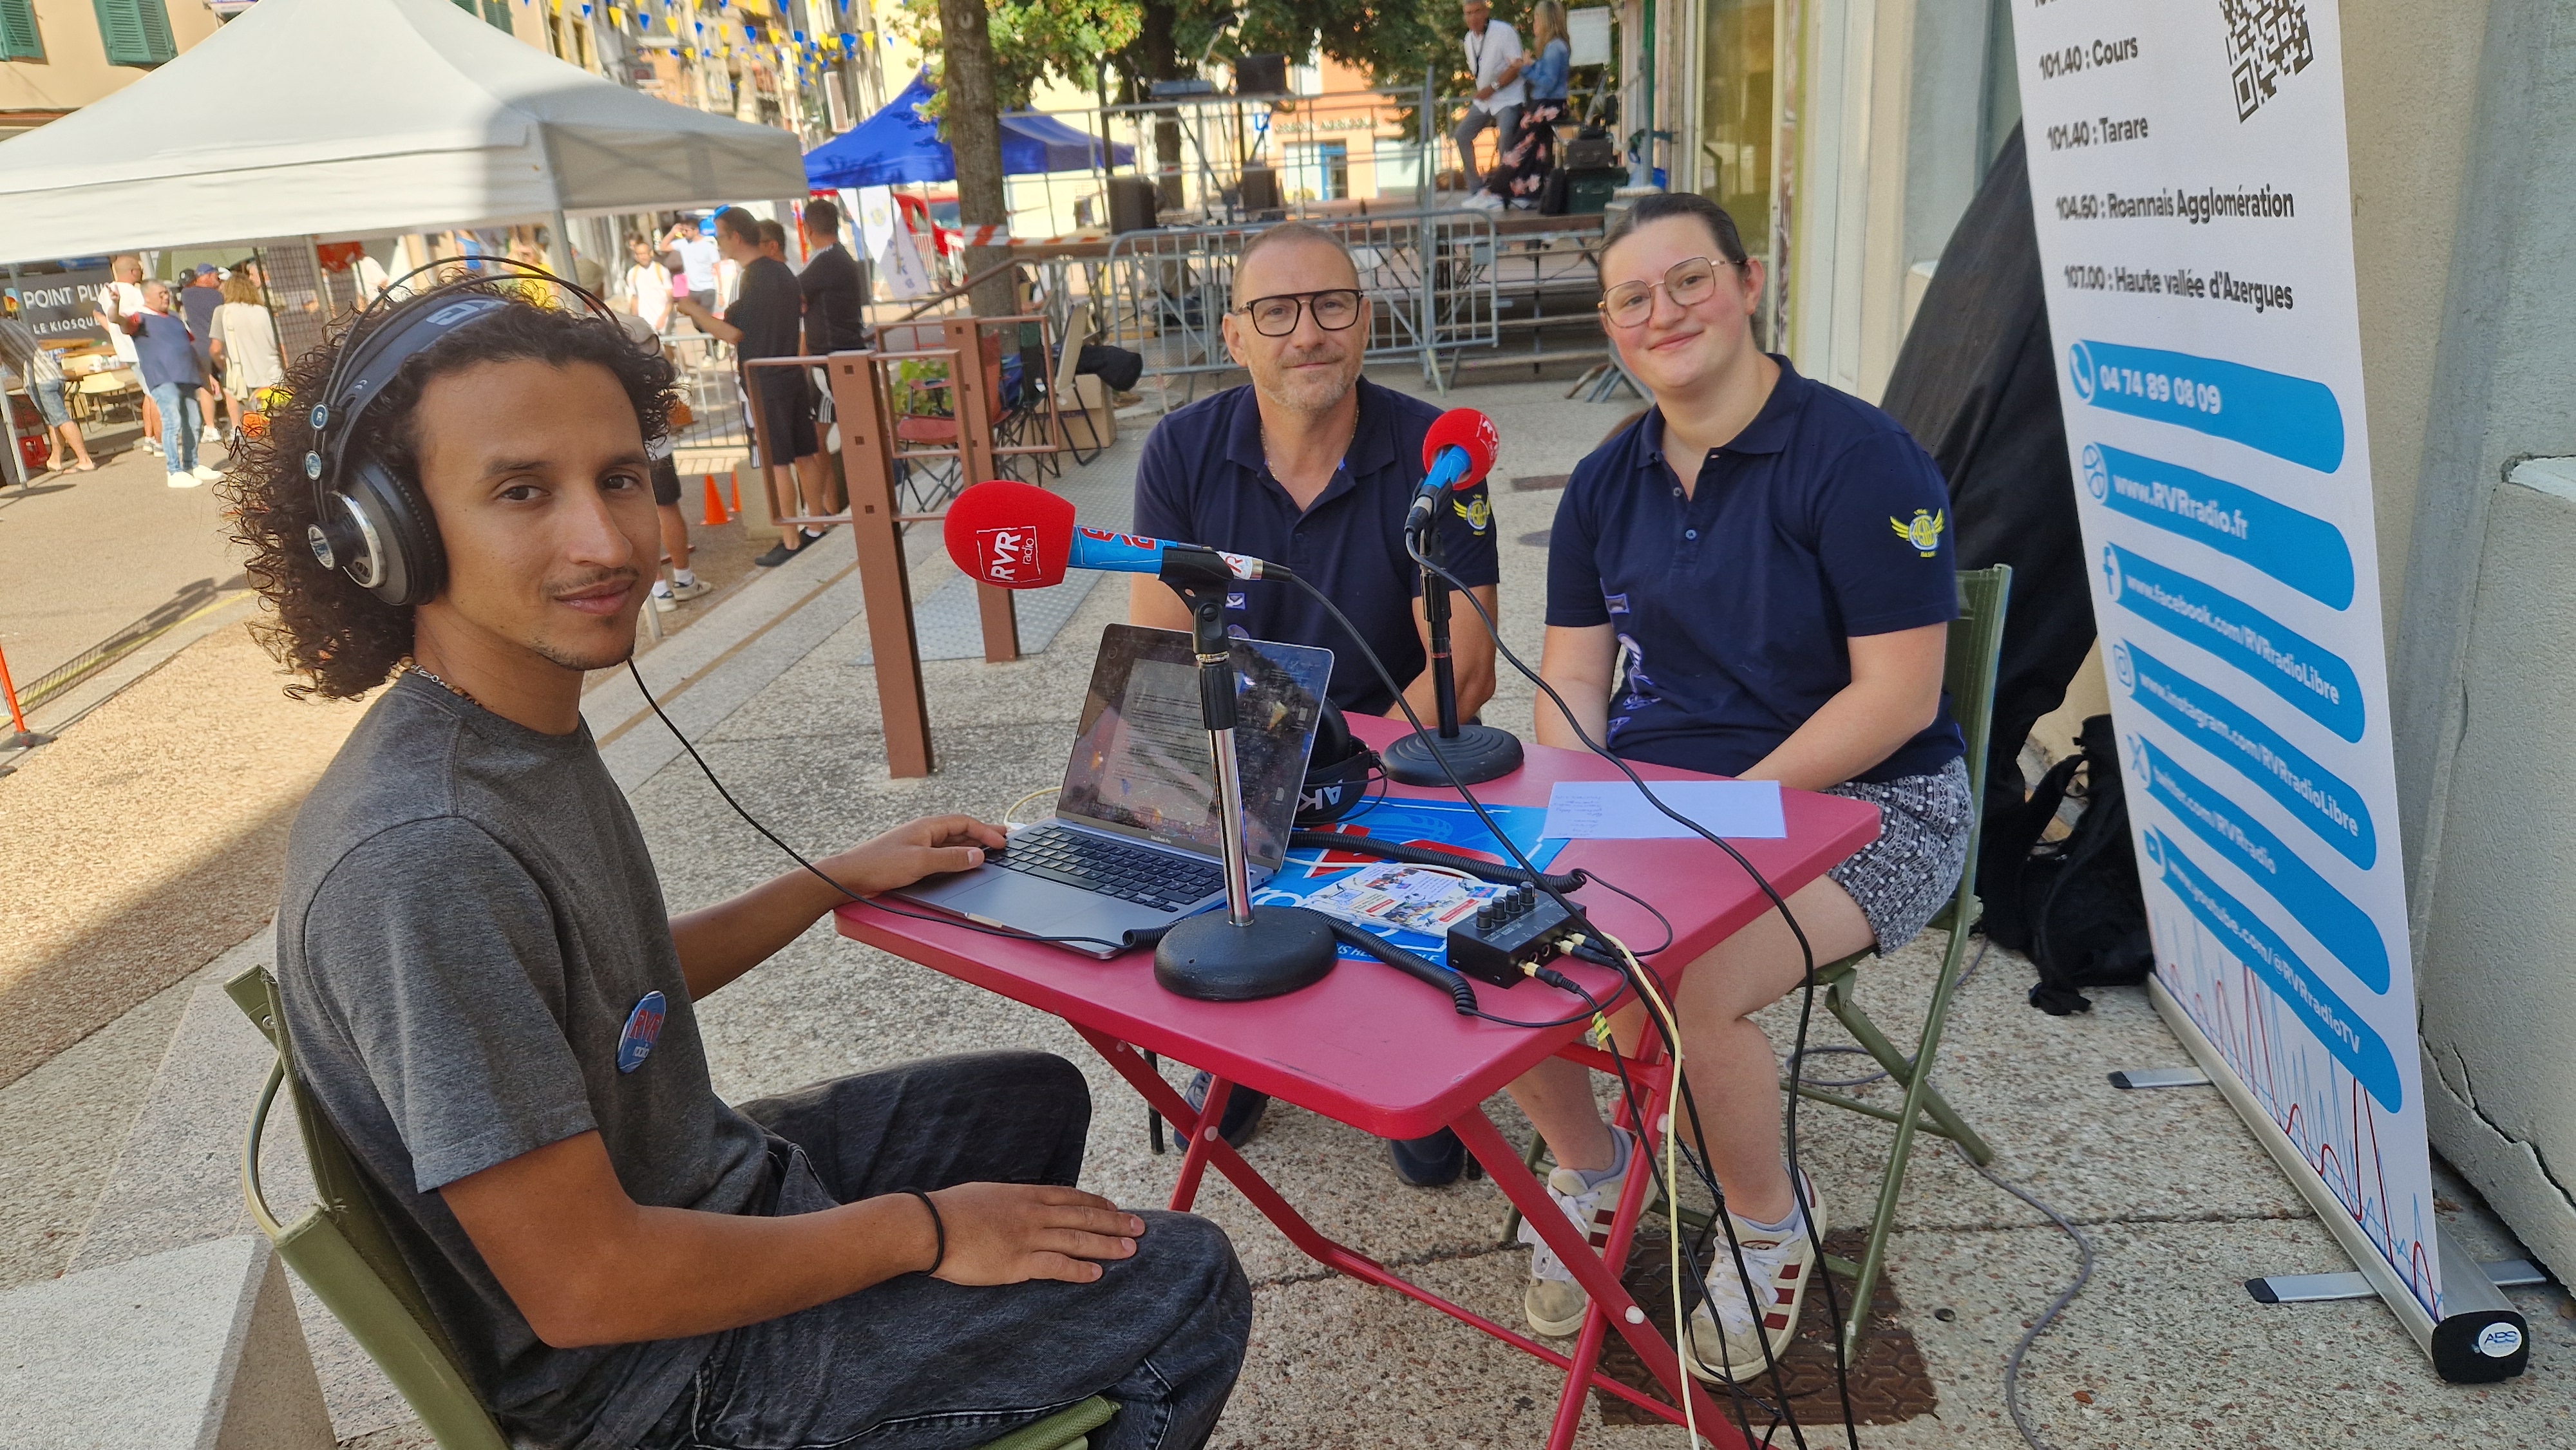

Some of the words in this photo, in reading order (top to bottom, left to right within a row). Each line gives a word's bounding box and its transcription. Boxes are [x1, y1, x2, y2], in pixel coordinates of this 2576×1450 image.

[2040, 46, 2082, 80] 101.40
[2092, 35, 2139, 67] Cours
[2099, 117, 2149, 144] Tarare
[2108, 189, 2174, 219] Roannais
[2177, 184, 2295, 225] Agglomération
[23, 287, 71, 310] POINT
[2115, 267, 2161, 294] Haute
[2164, 269, 2205, 299] vallée
[2210, 270, 2294, 314] d'Azergues
[33, 323, 47, 334] LE
[50, 315, 101, 333] KIOSQUE
[2100, 364, 2121, 393] 04
[2121, 369, 2144, 399] 74
[2146, 372, 2170, 402] 89
[2174, 377, 2195, 408] 08
[2197, 382, 2221, 415] 09
[2113, 475, 2249, 540] www.RVRradio.fr
[990, 530, 1022, 581] RVR
[1021, 538, 1036, 565] radio
[2125, 574, 2340, 706] www.facebook.com/RVRradioLibre
[628, 1008, 664, 1043] RVR
[2484, 1330, 2518, 1345] ABS
